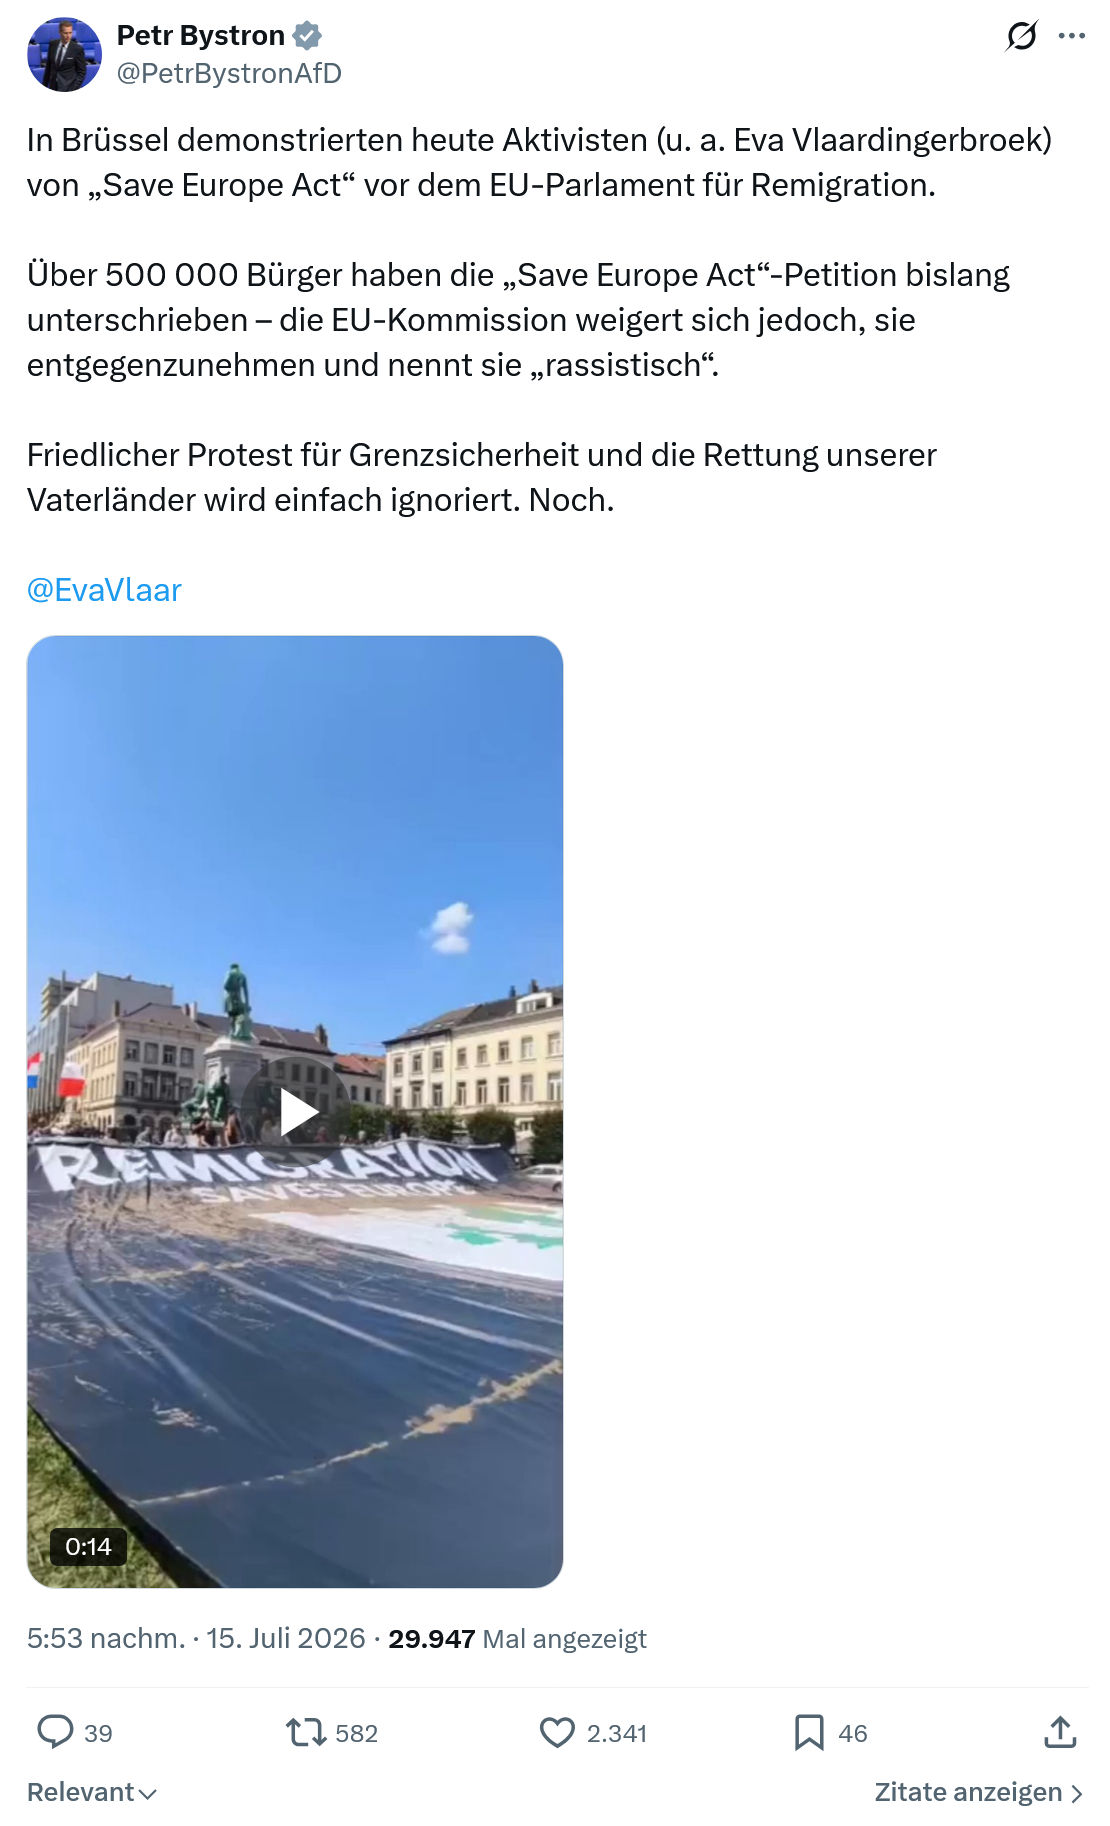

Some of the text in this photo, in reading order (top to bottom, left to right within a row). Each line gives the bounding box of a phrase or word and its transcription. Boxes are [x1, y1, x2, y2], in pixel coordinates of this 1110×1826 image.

[118, 25, 284, 50] Petr Bystron
[118, 62, 341, 88] @PetrBystronAfD
[29, 126, 1051, 157] In Brüssel demonstrierten heute Aktivisten (u. a. Eva Vlaardingerbroek)
[27, 172, 934, 202] von „Save Europe Act“ vor dem EU-Parlament für Remigration.
[29, 258, 1010, 292] Über 500 000 Bürger haben die „Save Europe Act“-Petition bislang
[28, 307, 247, 331] unterschrieben
[280, 307, 323, 331] die
[333, 307, 566, 331] EU-Kommission
[576, 307, 683, 337] weigert
[692, 307, 749, 331] sich
[756, 307, 865, 337] jedoch,
[875, 307, 915, 331] sie
[28, 352, 718, 382] entgegenzunehmen und nennt sie „rassistisch“.
[29, 442, 937, 472] Friedlicher Protest für Grenzsicherheit und die Rettung unserer
[27, 487, 613, 517] Vaterländer wird einfach ignoriert. Noch.
[28, 577, 182, 603] @EvaVlaar
[37, 1142, 498, 1192] REMIGRATION
[190, 1183, 344, 1203] SAVES
[65, 1537, 112, 1556] 0:14
[28, 1628, 82, 1648] 5:53
[92, 1627, 184, 1648] nachm.
[207, 1628, 241, 1648] 15.
[249, 1626, 289, 1648] Juli
[299, 1628, 365, 1648] 2026
[389, 1630, 475, 1648] 29.947
[484, 1628, 525, 1648] Mal
[534, 1628, 647, 1653] angezeigt
[85, 1725, 112, 1742] 39
[336, 1725, 377, 1742] 582
[588, 1725, 645, 1742] 2.341
[839, 1725, 867, 1742] 46
[28, 1781, 135, 1801] Relevant
[876, 1781, 1061, 1806] Zitate anzeigen
